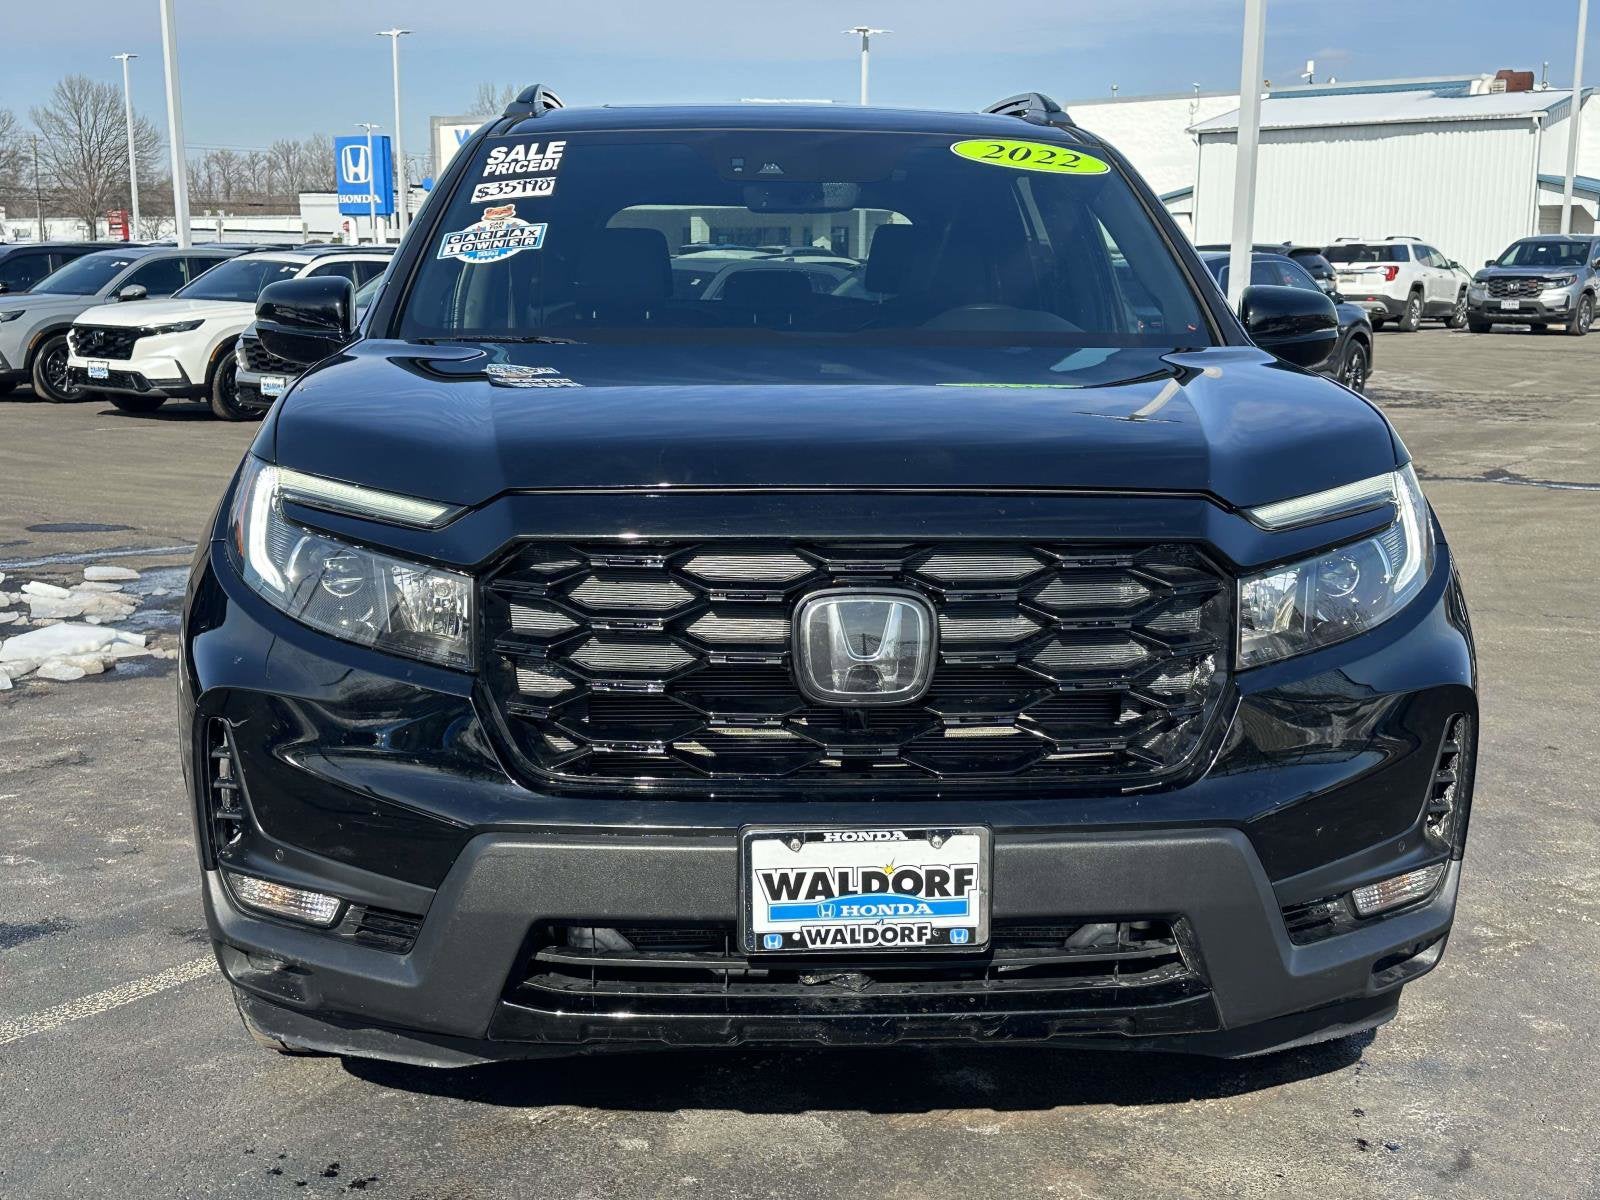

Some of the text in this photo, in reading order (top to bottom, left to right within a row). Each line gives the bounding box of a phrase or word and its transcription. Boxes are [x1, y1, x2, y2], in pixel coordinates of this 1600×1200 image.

[486, 141, 567, 165] SALE
[980, 144, 1081, 168] 2022
[482, 158, 561, 177] PRICED!
[340, 194, 382, 203] HONDA
[449, 229, 538, 244] CARFAX
[461, 237, 536, 252] OWNER
[823, 831, 909, 843] HONDA
[761, 867, 974, 901] WALDORF
[840, 903, 934, 917] HONDA
[805, 926, 930, 946] WALDORF
